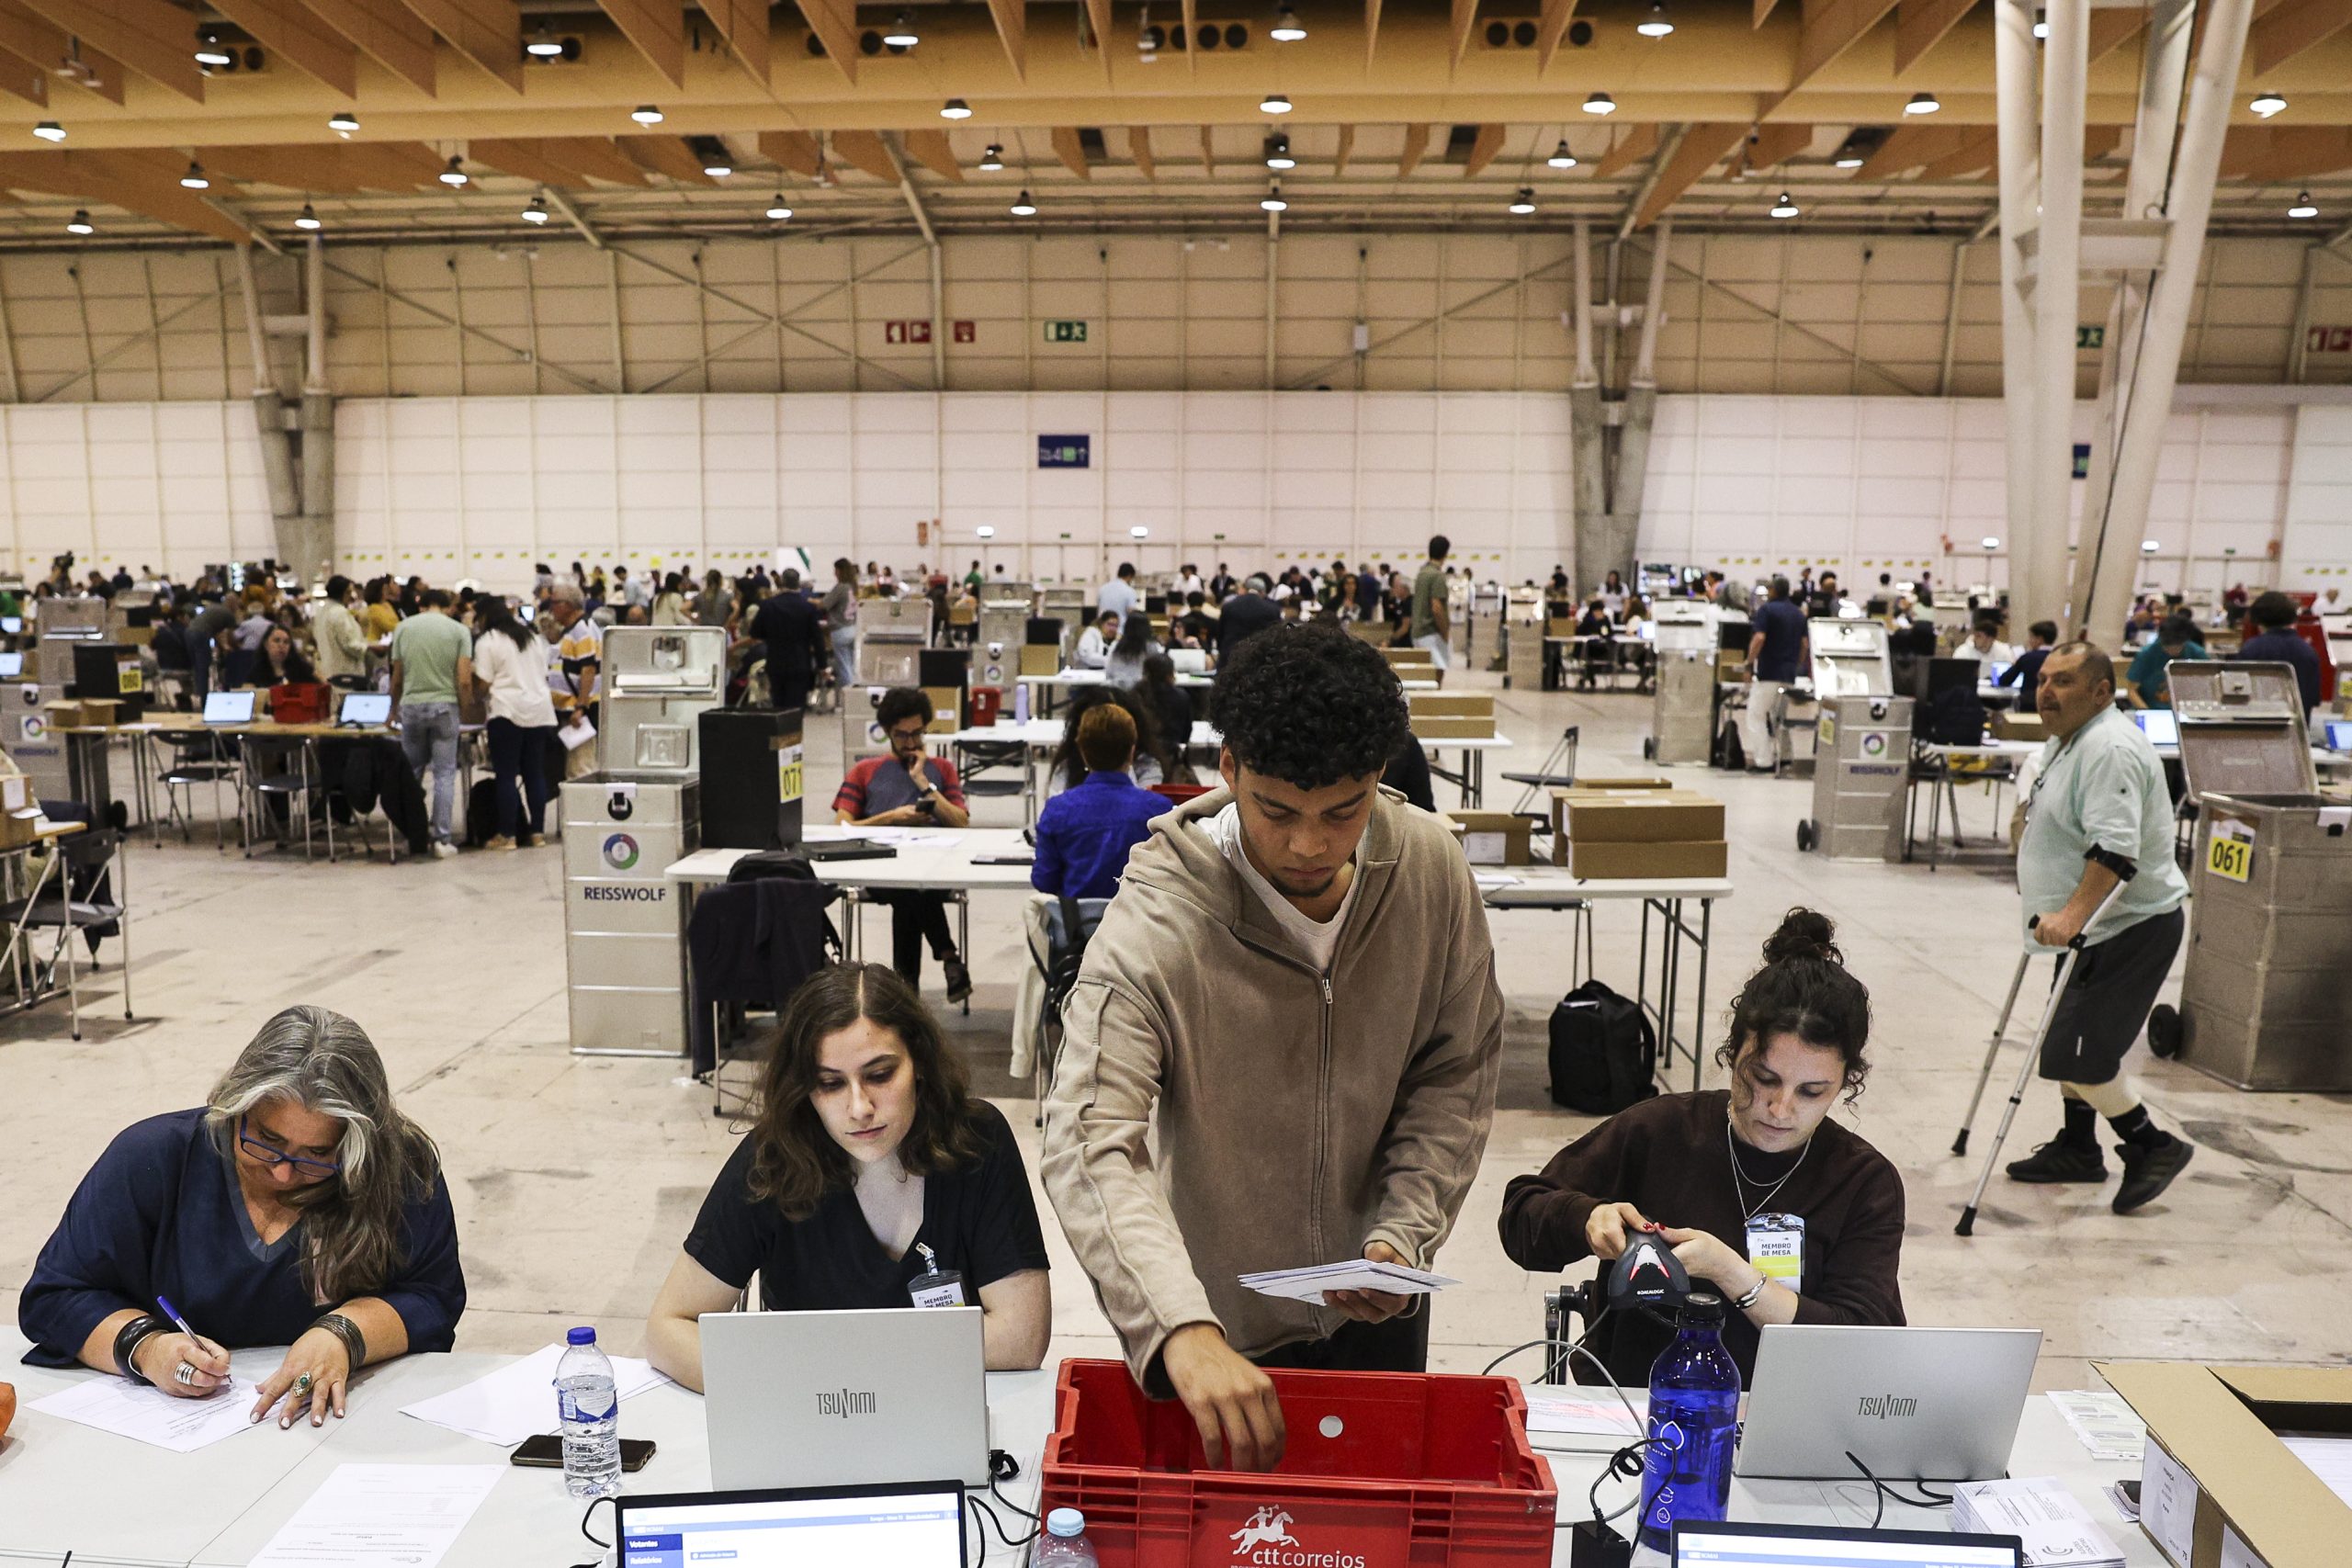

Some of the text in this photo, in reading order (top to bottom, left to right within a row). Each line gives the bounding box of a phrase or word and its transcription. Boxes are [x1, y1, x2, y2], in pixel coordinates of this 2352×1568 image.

[2212, 841, 2245, 874] 061
[583, 886, 666, 901] REISSWOLF
[923, 1294, 953, 1305] MEMBRO
[935, 1300, 955, 1308] MESA
[628, 1540, 659, 1549] Votantes
